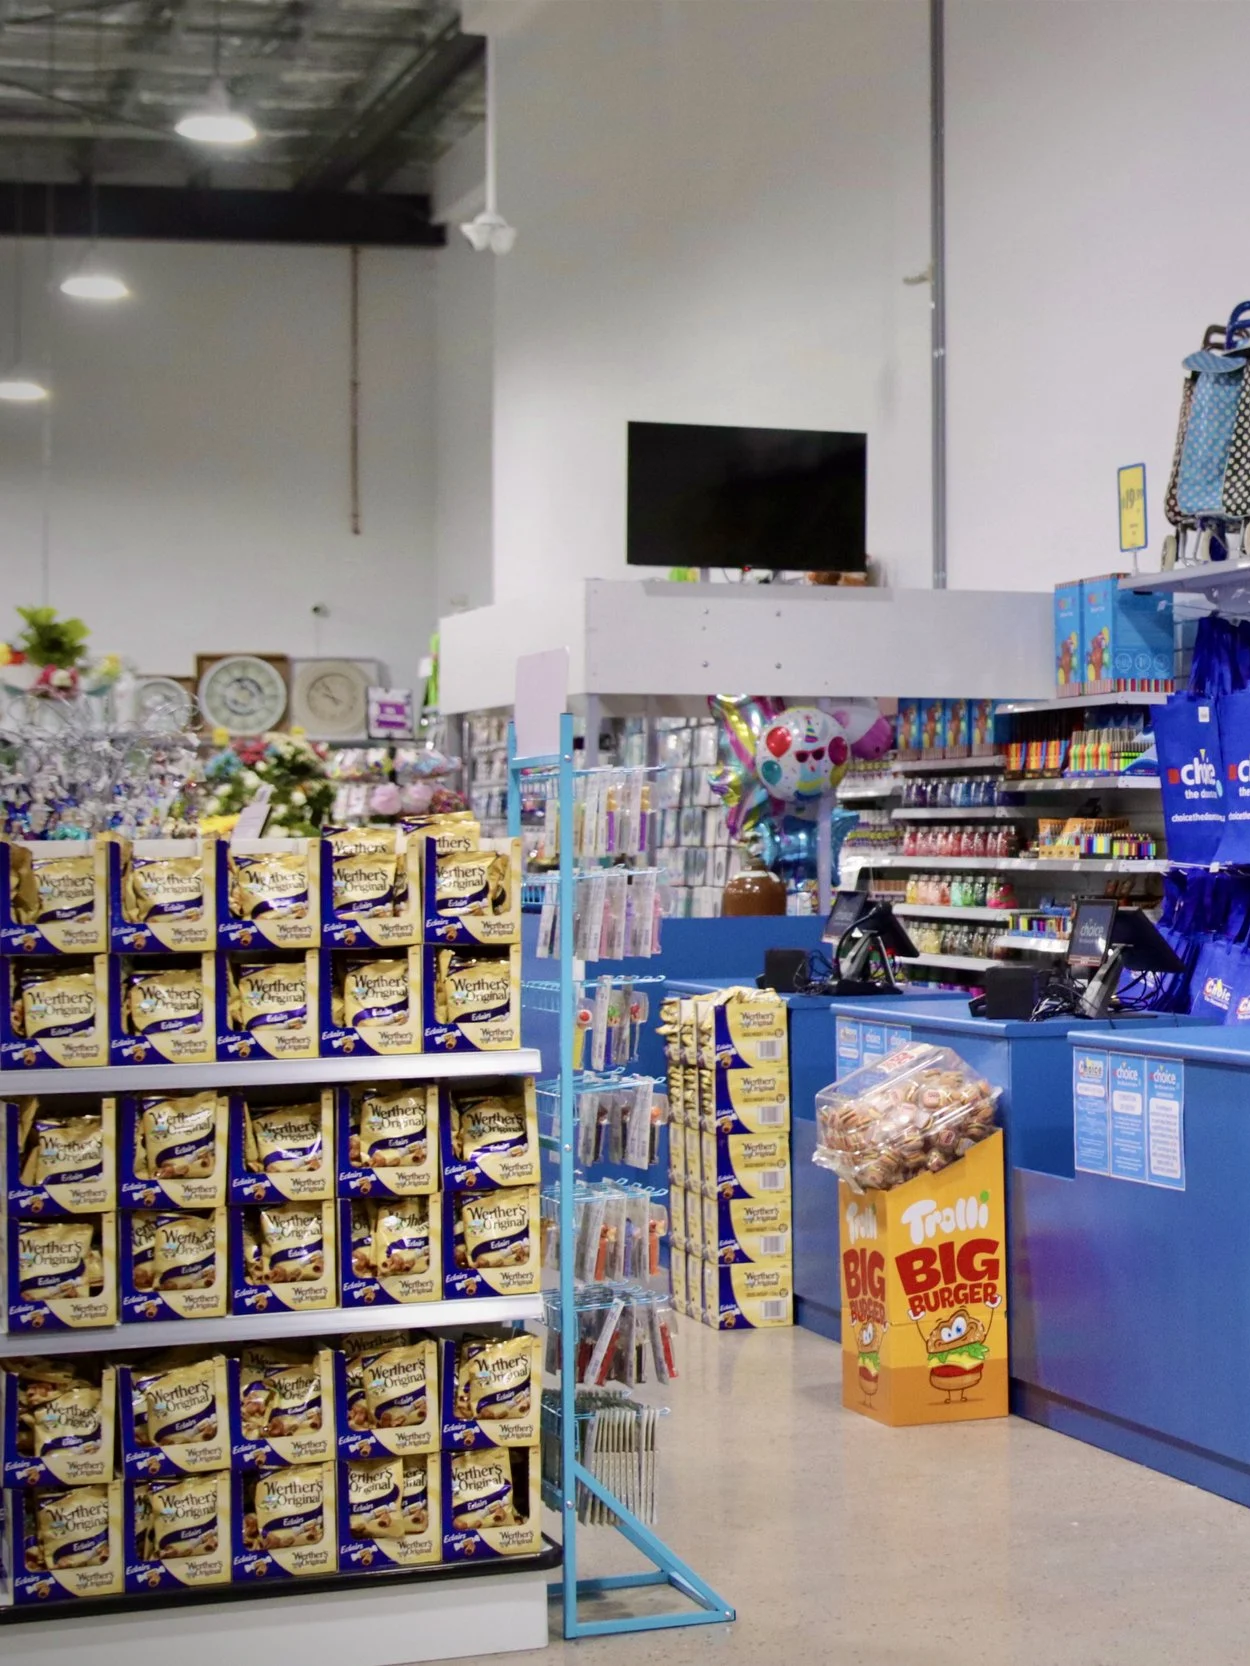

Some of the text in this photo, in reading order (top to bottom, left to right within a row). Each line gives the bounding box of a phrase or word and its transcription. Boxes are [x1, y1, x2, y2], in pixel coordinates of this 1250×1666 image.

[247, 979, 306, 993] Werther's
[352, 975, 408, 989] Werther's
[450, 978, 508, 991] Werther's
[29, 992, 94, 1005] Werther's
[46, 1004, 92, 1018] Original
[468, 1206, 526, 1221] Werther's
[901, 1191, 989, 1245] Trolli
[20, 1240, 82, 1253] Werther's
[33, 1253, 81, 1265] Original
[895, 1238, 999, 1296] BIG
[843, 1248, 885, 1302] BIG
[908, 1283, 998, 1317] BURGER
[370, 1361, 424, 1379] Werther's
[384, 1374, 425, 1388] Original
[150, 1380, 209, 1403] Werther's
[166, 1395, 209, 1412] Original
[350, 1468, 392, 1482] erther's
[264, 1480, 323, 1495] Werther's
[160, 1491, 217, 1507] Werther's
[277, 1493, 320, 1507] Original
